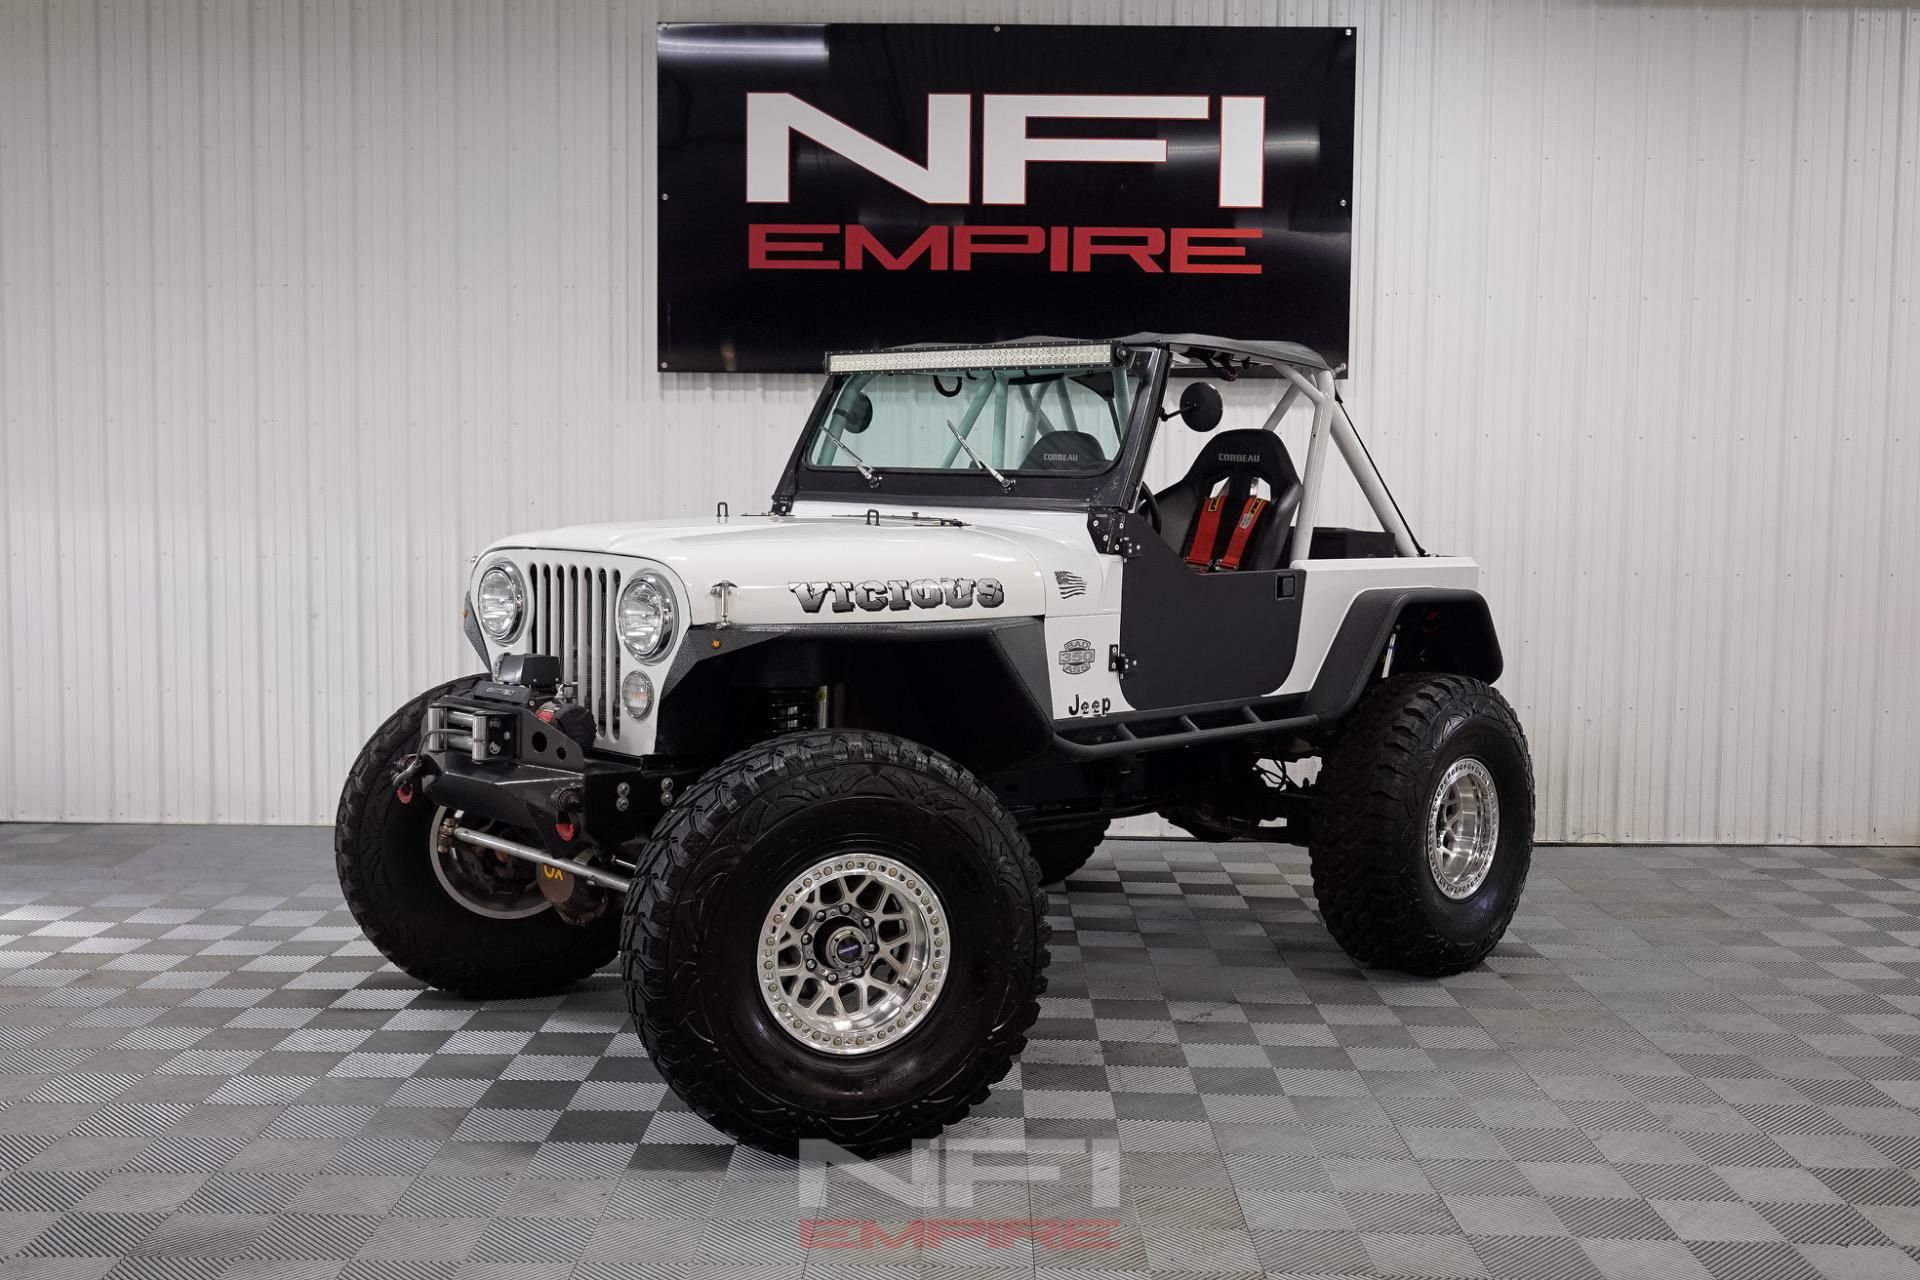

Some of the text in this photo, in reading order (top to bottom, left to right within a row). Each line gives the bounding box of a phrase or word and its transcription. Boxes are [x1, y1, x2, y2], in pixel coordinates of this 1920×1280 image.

[746, 91, 1266, 207] NFI
[747, 224, 1264, 274] EMPIRE
[1043, 453, 1078, 462] CORBEAU
[1218, 453, 1260, 463] CORBEAU
[787, 577, 1005, 613] VICIOUS
[1067, 640, 1090, 650] BAD
[1061, 651, 1094, 663] 350
[1065, 663, 1090, 673] ASS
[1068, 694, 1111, 715] Jeep
